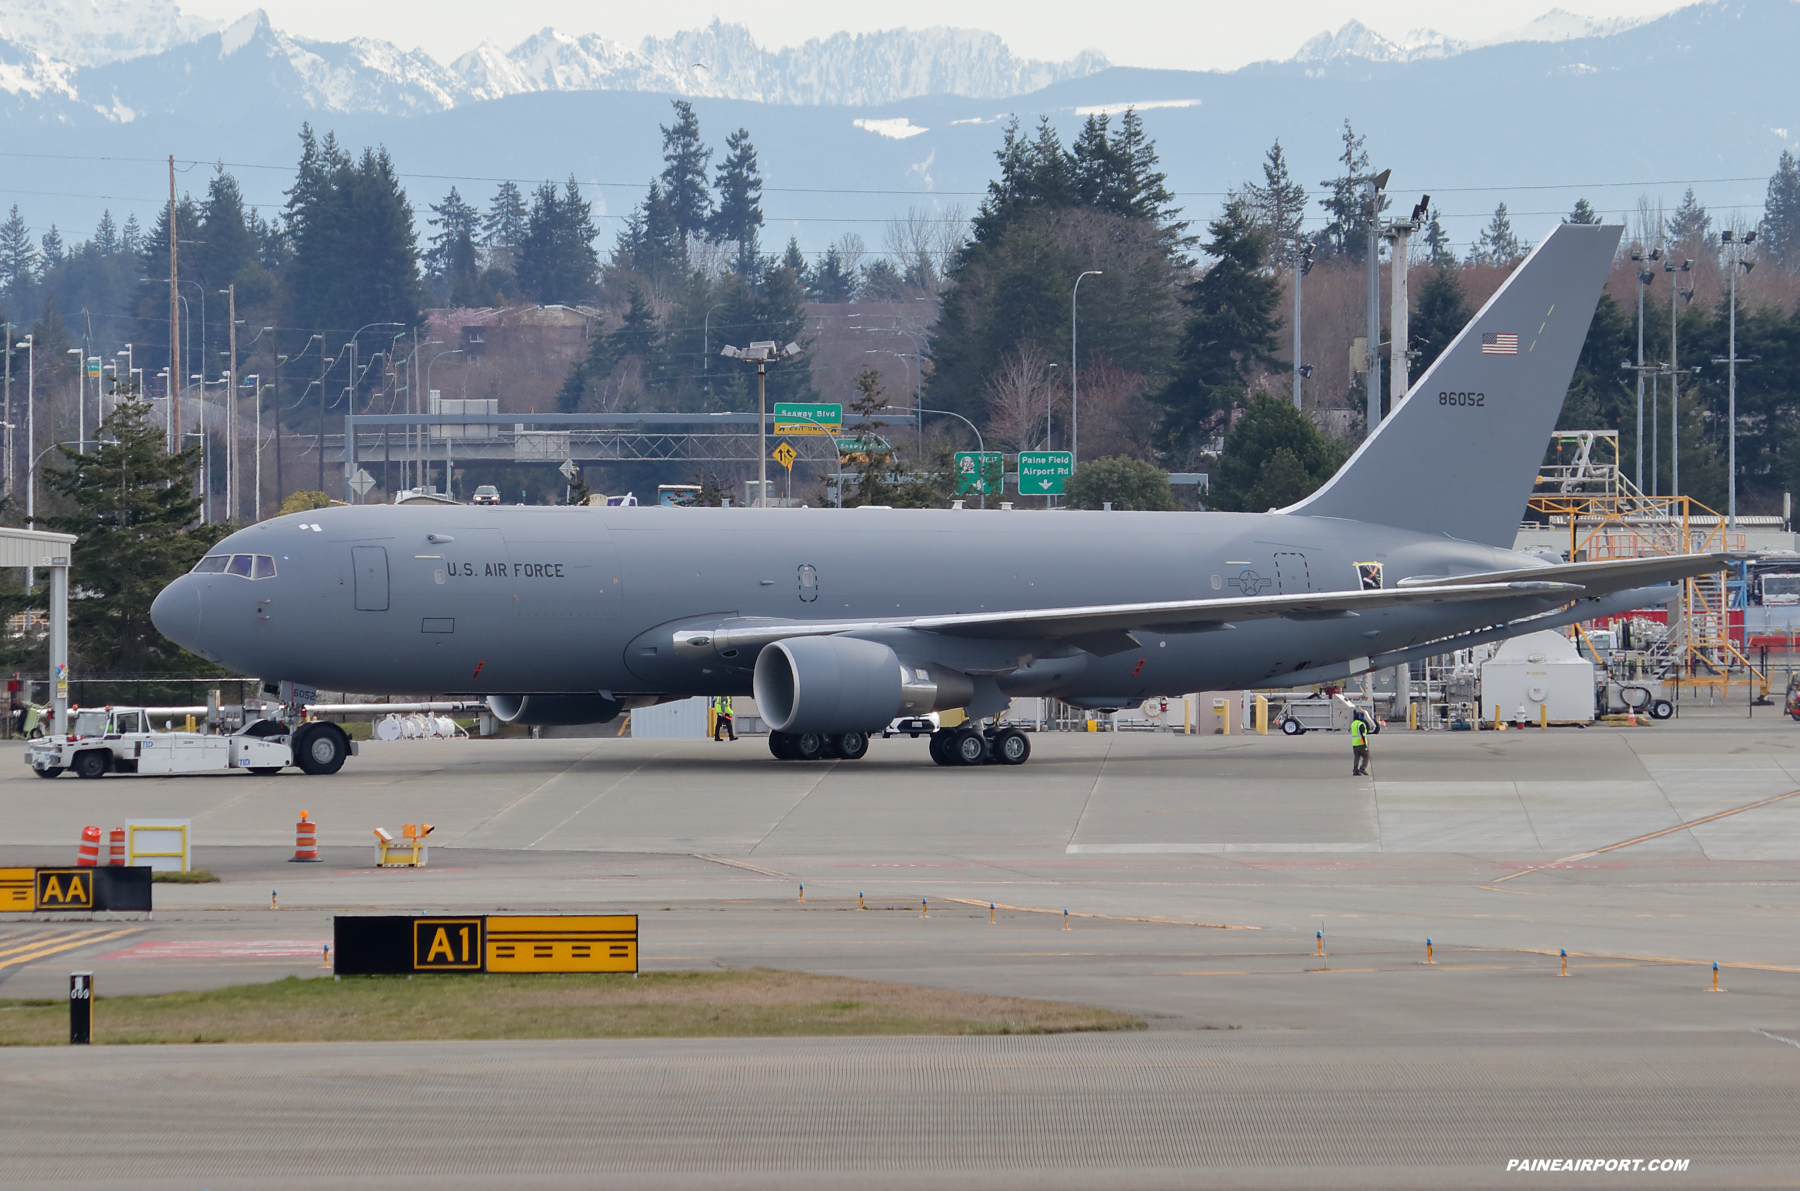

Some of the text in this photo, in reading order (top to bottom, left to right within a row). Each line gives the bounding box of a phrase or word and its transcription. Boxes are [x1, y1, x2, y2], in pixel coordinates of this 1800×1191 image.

[1439, 391, 1485, 407] 86052
[781, 409, 813, 418] Seaway
[1022, 456, 1069, 464] Paine Field
[1022, 467, 1069, 476] Airport Rd
[447, 562, 565, 578] U.S. AIR FORCE
[293, 688, 316, 701] 6052
[42, 875, 88, 903] AA
[426, 926, 469, 962] A1
